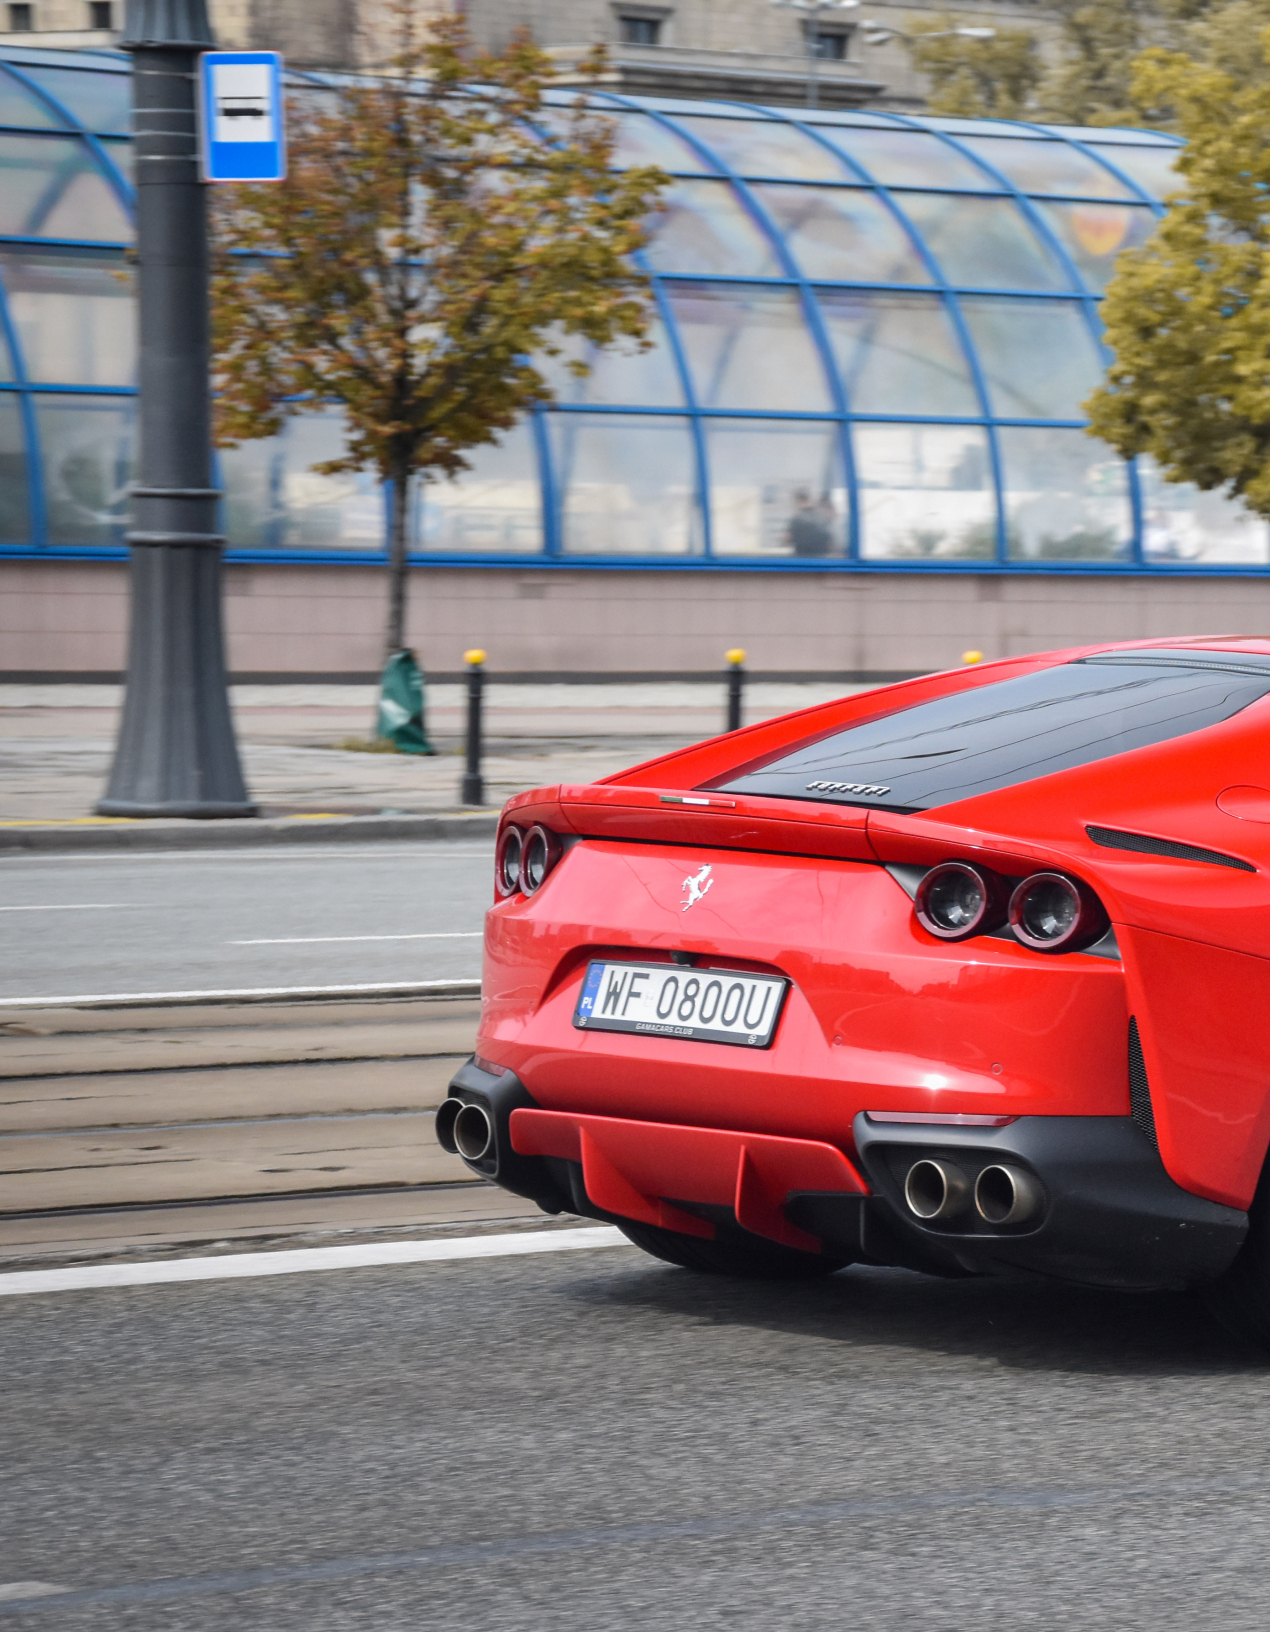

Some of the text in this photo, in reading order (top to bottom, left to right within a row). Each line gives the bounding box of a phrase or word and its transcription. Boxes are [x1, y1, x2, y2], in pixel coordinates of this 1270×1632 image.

[580, 996, 593, 1010] PL
[636, 1022, 694, 1035] GAMACARS CLUB
